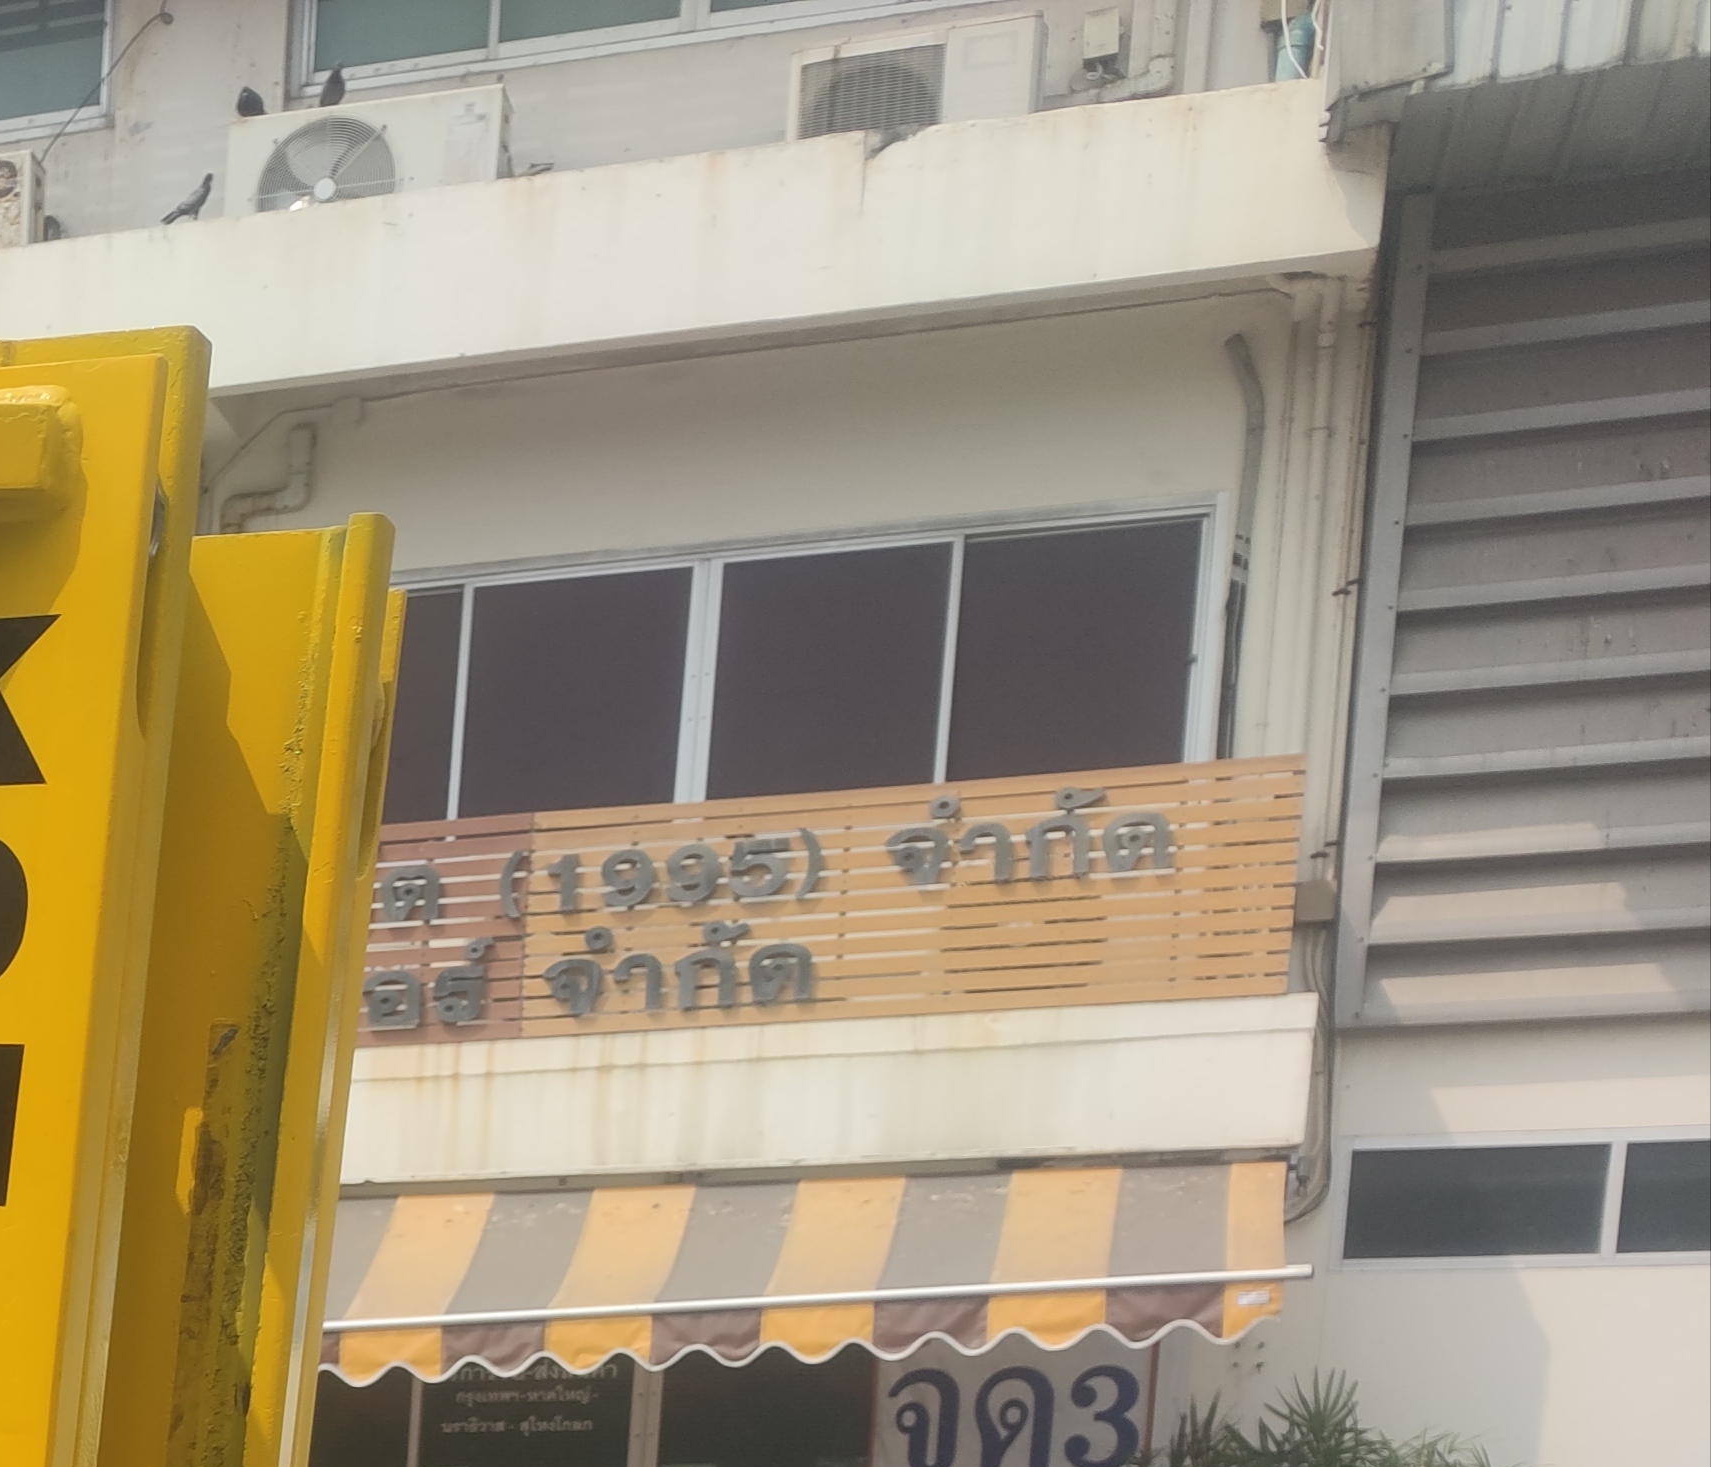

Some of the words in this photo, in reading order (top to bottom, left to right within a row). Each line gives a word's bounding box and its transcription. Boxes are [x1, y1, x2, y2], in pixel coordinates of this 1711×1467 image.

[500, 828, 828, 921] (1995)
[884, 786, 1175, 887] จำกัด
[542, 918, 818, 1018] จำกัด
